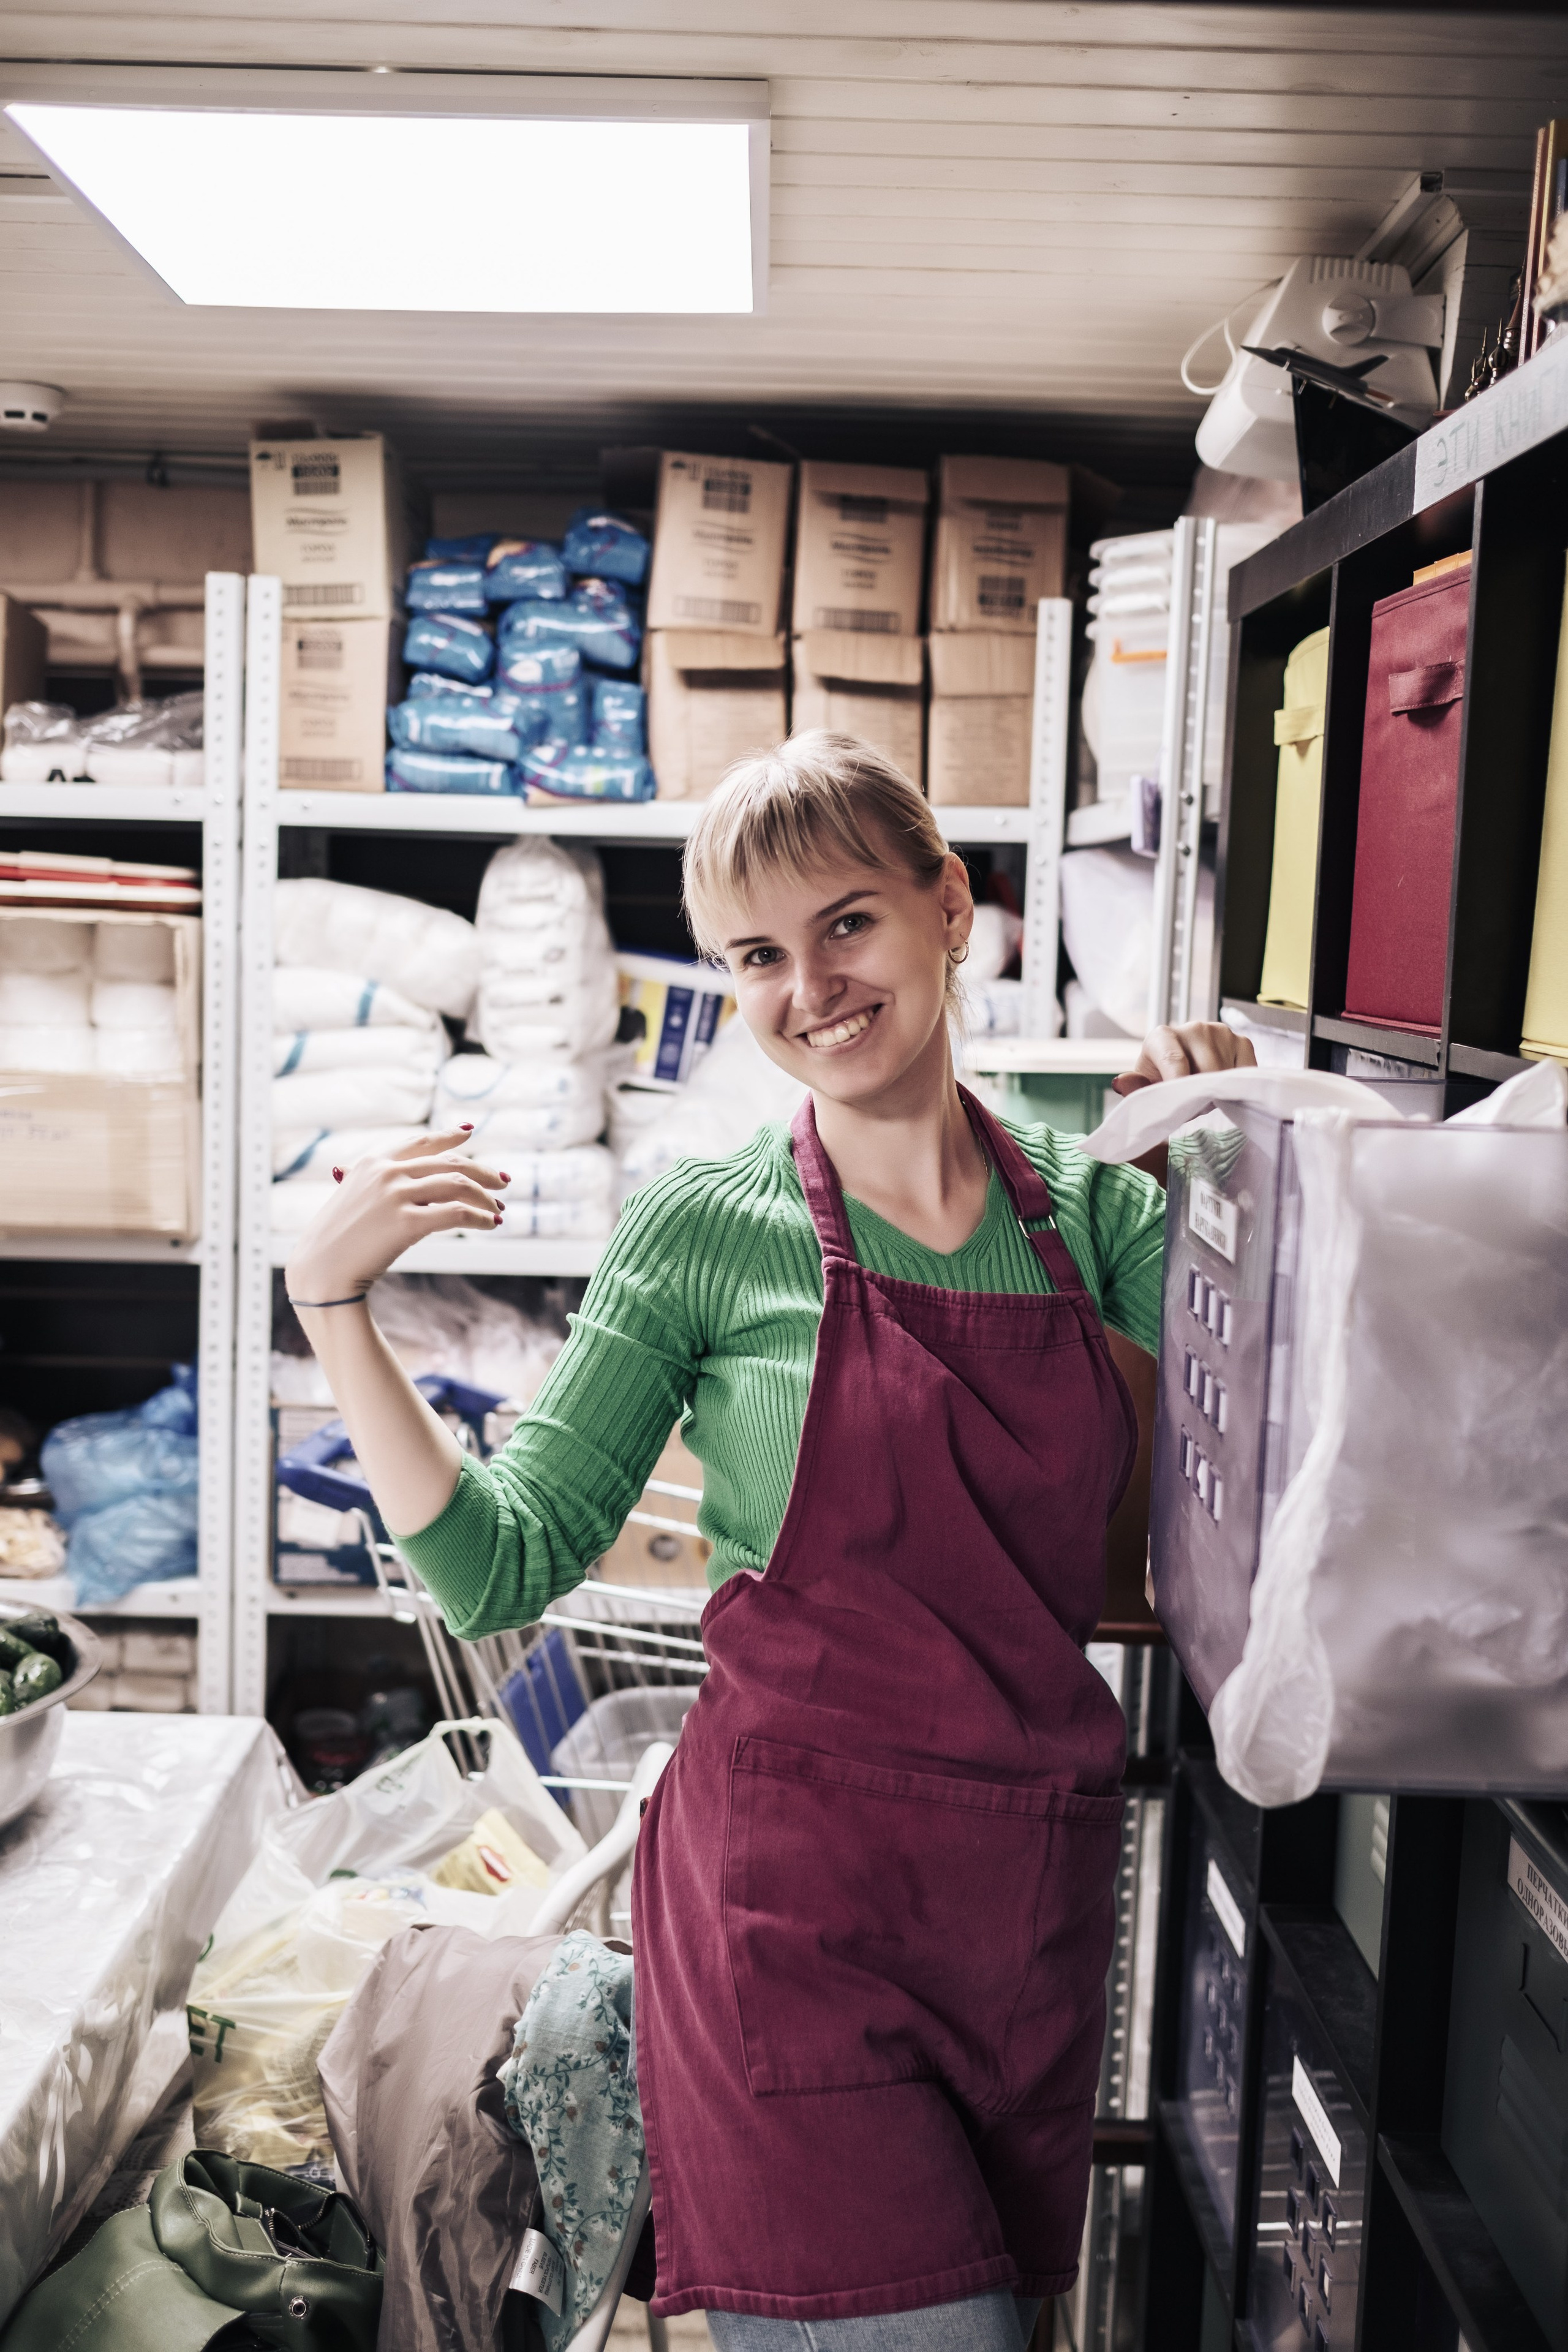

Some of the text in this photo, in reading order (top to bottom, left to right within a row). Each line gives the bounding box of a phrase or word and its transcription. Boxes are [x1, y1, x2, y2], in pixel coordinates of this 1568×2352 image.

[1433, 415, 1480, 488] ЭТИ
[1527, 1863, 1568, 1929] ПЕРЧАТКИ
[524, 2237, 536, 2254] MADE
[529, 2258, 539, 2274] FABER
[538, 2251, 548, 2269] SLEEVE
[515, 2261, 526, 2278] CHINA
